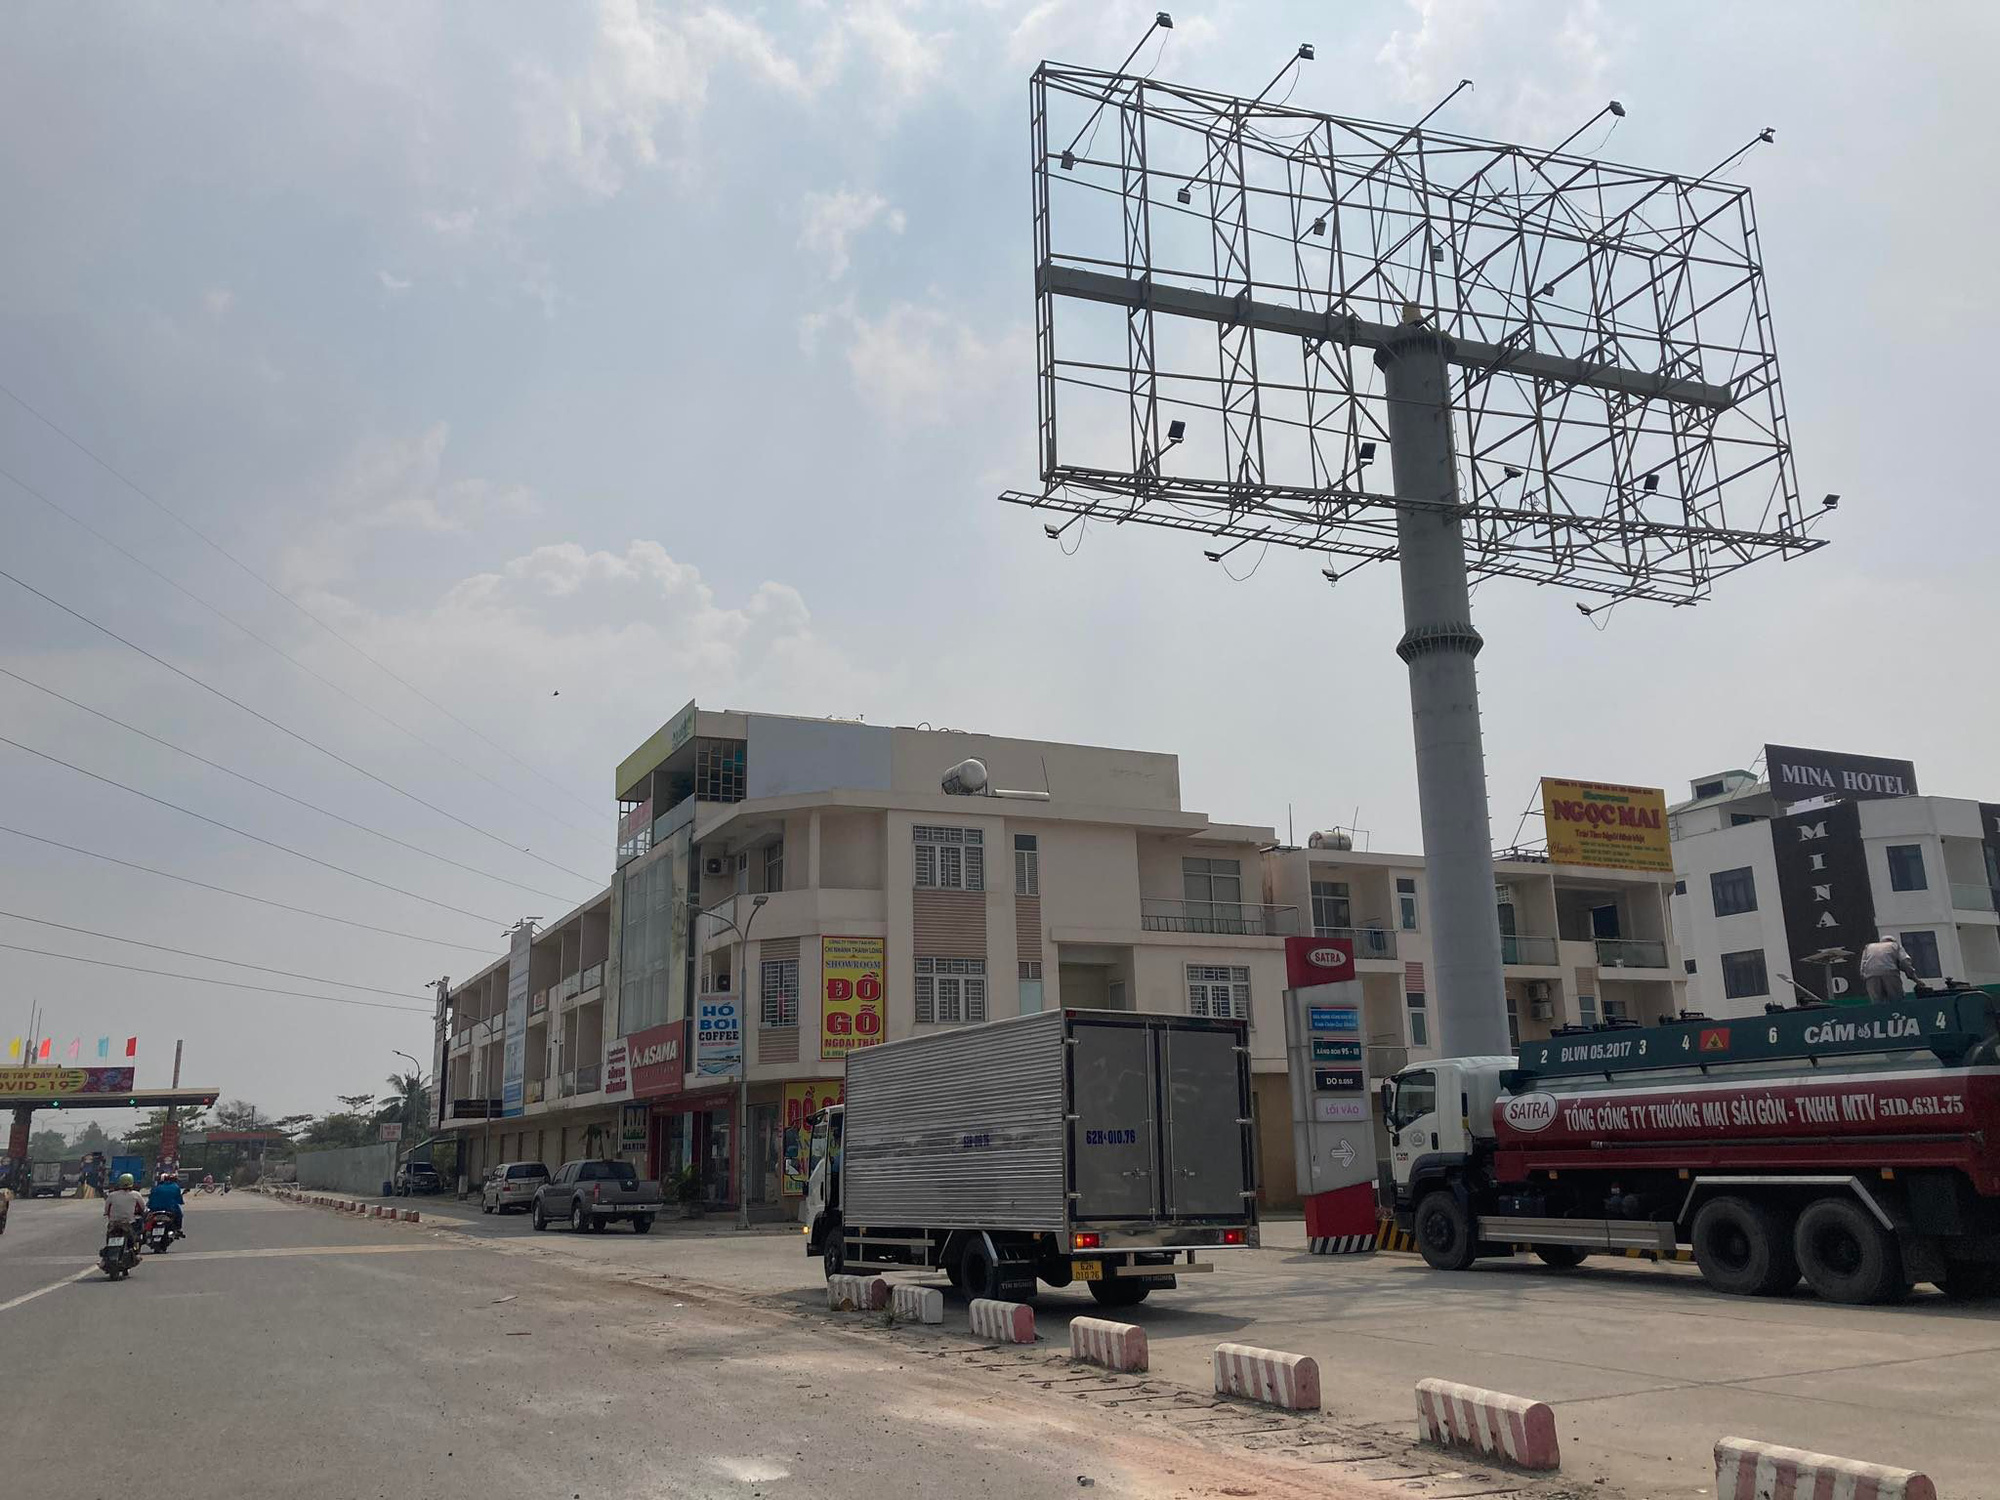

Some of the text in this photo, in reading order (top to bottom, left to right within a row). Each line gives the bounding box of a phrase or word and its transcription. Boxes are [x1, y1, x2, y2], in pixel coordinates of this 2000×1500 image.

[1781, 763, 1909, 795] MINA HOTEL
[1552, 799, 1661, 829] NGỌC MAI
[1798, 820, 1840, 928] MINA
[826, 960, 880, 969] SHOWROOM
[1315, 952, 1341, 963] SATRA
[826, 971, 881, 1001] ĐỒ
[827, 1004, 880, 1035] GỖ
[1804, 1011, 1946, 1044] CẤM LỬA 4
[698, 1030, 739, 1042] COFFEE
[1540, 1027, 1777, 1063] 2 ĐLVN 05.2017 3 4 6
[641, 1040, 678, 1066] ASAMA
[1326, 1077, 1337, 1085] DO
[1510, 1102, 1551, 1119] SATRA
[1564, 1098, 1595, 1131] TỔNG
[1597, 1101, 1629, 1130] CÔNG
[1630, 1105, 1646, 1129] TY
[1648, 1098, 1701, 1128] THƯƠNG
[1702, 1100, 1729, 1130] MẠI
[1731, 1094, 1755, 1126] SÀI
[1756, 1092, 1788, 1125] GÒN
[1795, 1096, 1838, 1124] TNHH
[1841, 1093, 1876, 1121] MTV
[1879, 1095, 1965, 1117] 51D.631.75
